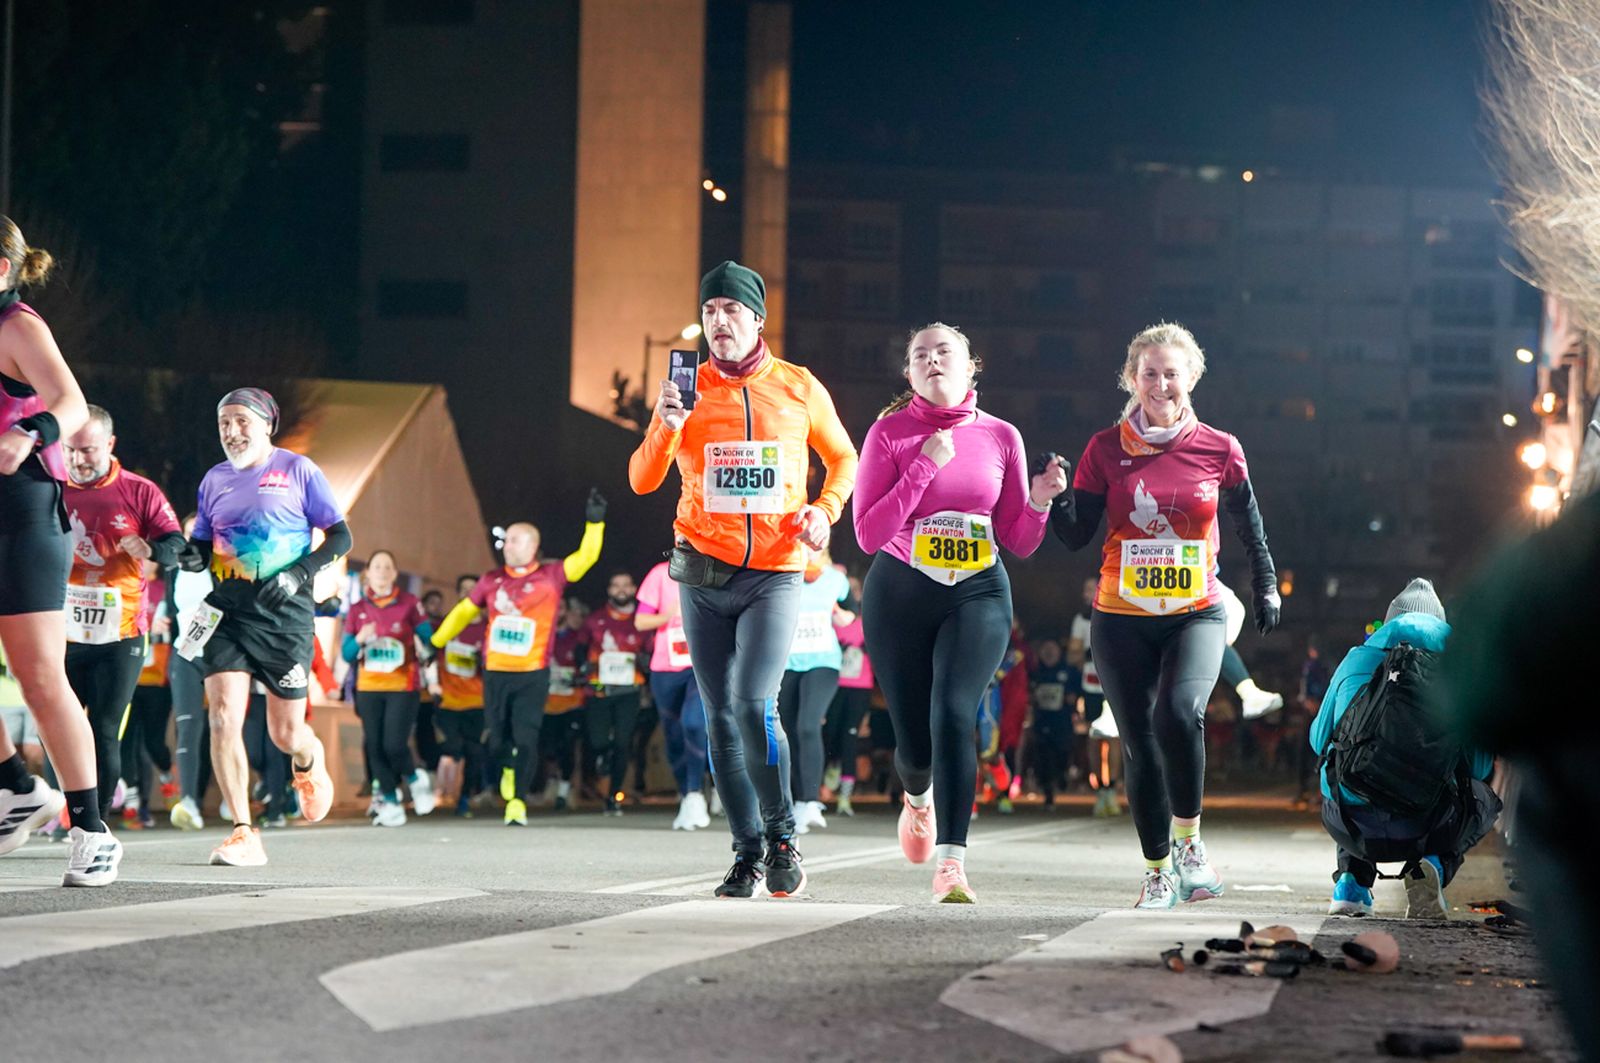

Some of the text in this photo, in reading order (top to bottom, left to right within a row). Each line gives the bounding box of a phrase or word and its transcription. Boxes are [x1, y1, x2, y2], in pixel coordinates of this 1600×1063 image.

[713, 467, 775, 489] 12850
[922, 527, 938, 535] SAN
[932, 518, 955, 528] NOCHE
[76, 541, 92, 557] 43
[929, 537, 979, 562] 3881
[1139, 547, 1164, 555] NOCHE
[1165, 547, 1174, 555] DE
[1130, 557, 1146, 566] SAN
[1135, 567, 1192, 590] 3880
[73, 606, 106, 625] 5177
